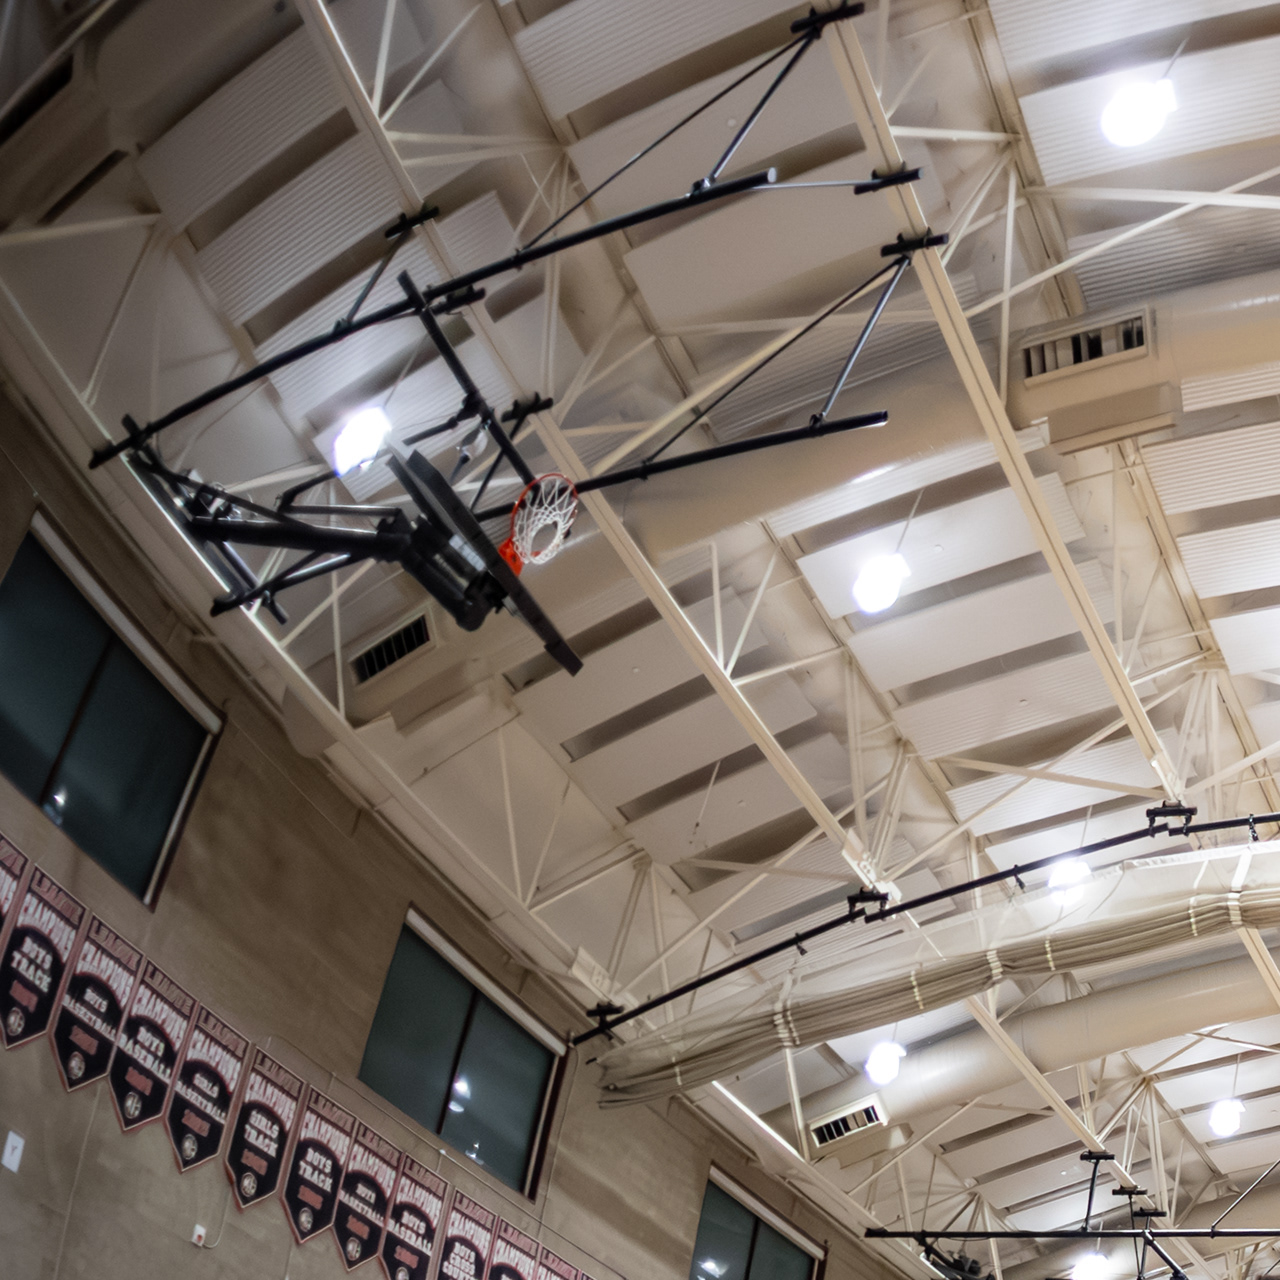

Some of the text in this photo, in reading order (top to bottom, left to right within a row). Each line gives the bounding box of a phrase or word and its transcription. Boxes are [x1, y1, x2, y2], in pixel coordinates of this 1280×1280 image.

[22, 936, 52, 970] BOYS
[11, 951, 51, 993] TRACK
[244, 1124, 278, 1158] TRACK
[250, 1111, 279, 1139] GIRLS
[299, 1161, 333, 1192] TRACK
[305, 1148, 332, 1173] BOYS
